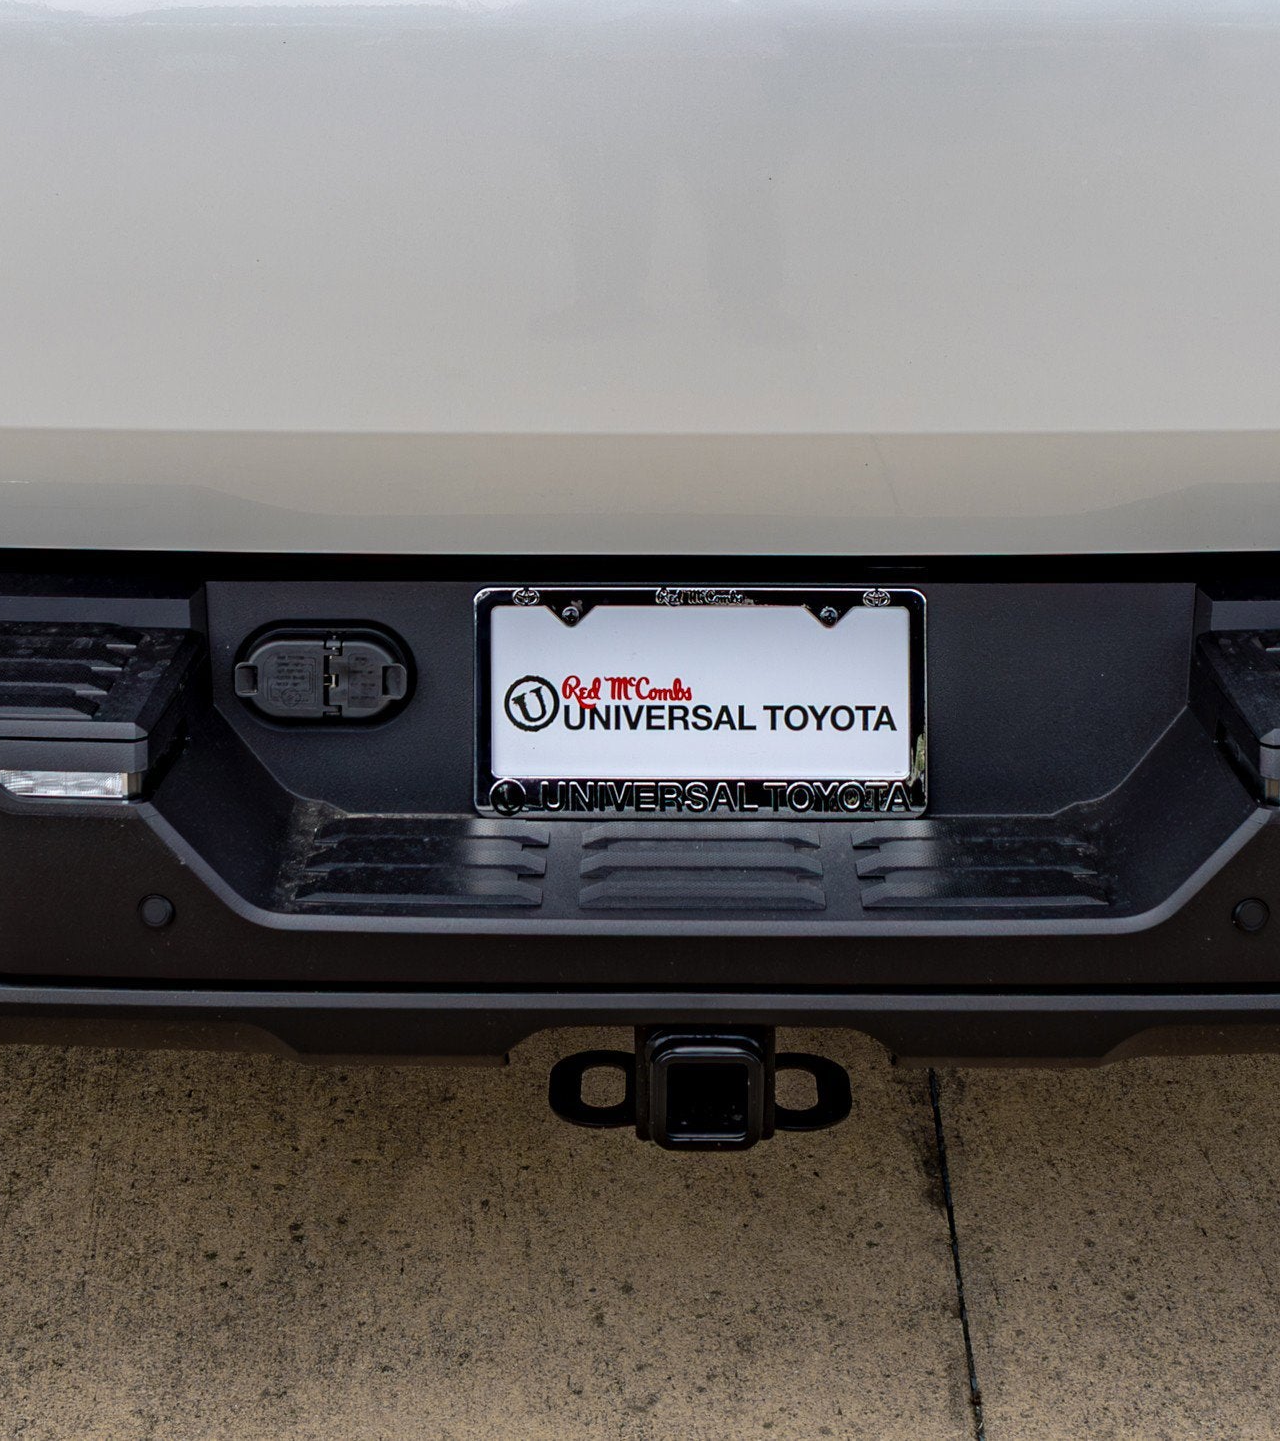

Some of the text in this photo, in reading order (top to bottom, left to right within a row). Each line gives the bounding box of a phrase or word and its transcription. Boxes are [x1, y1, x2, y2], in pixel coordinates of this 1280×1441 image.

[655, 587, 745, 606] Red McCombs
[561, 675, 693, 710] Red McCombs
[563, 704, 898, 732] UNIVERSAL TOYOTA
[540, 780, 915, 813] UNIVERSAL TOYOTA
